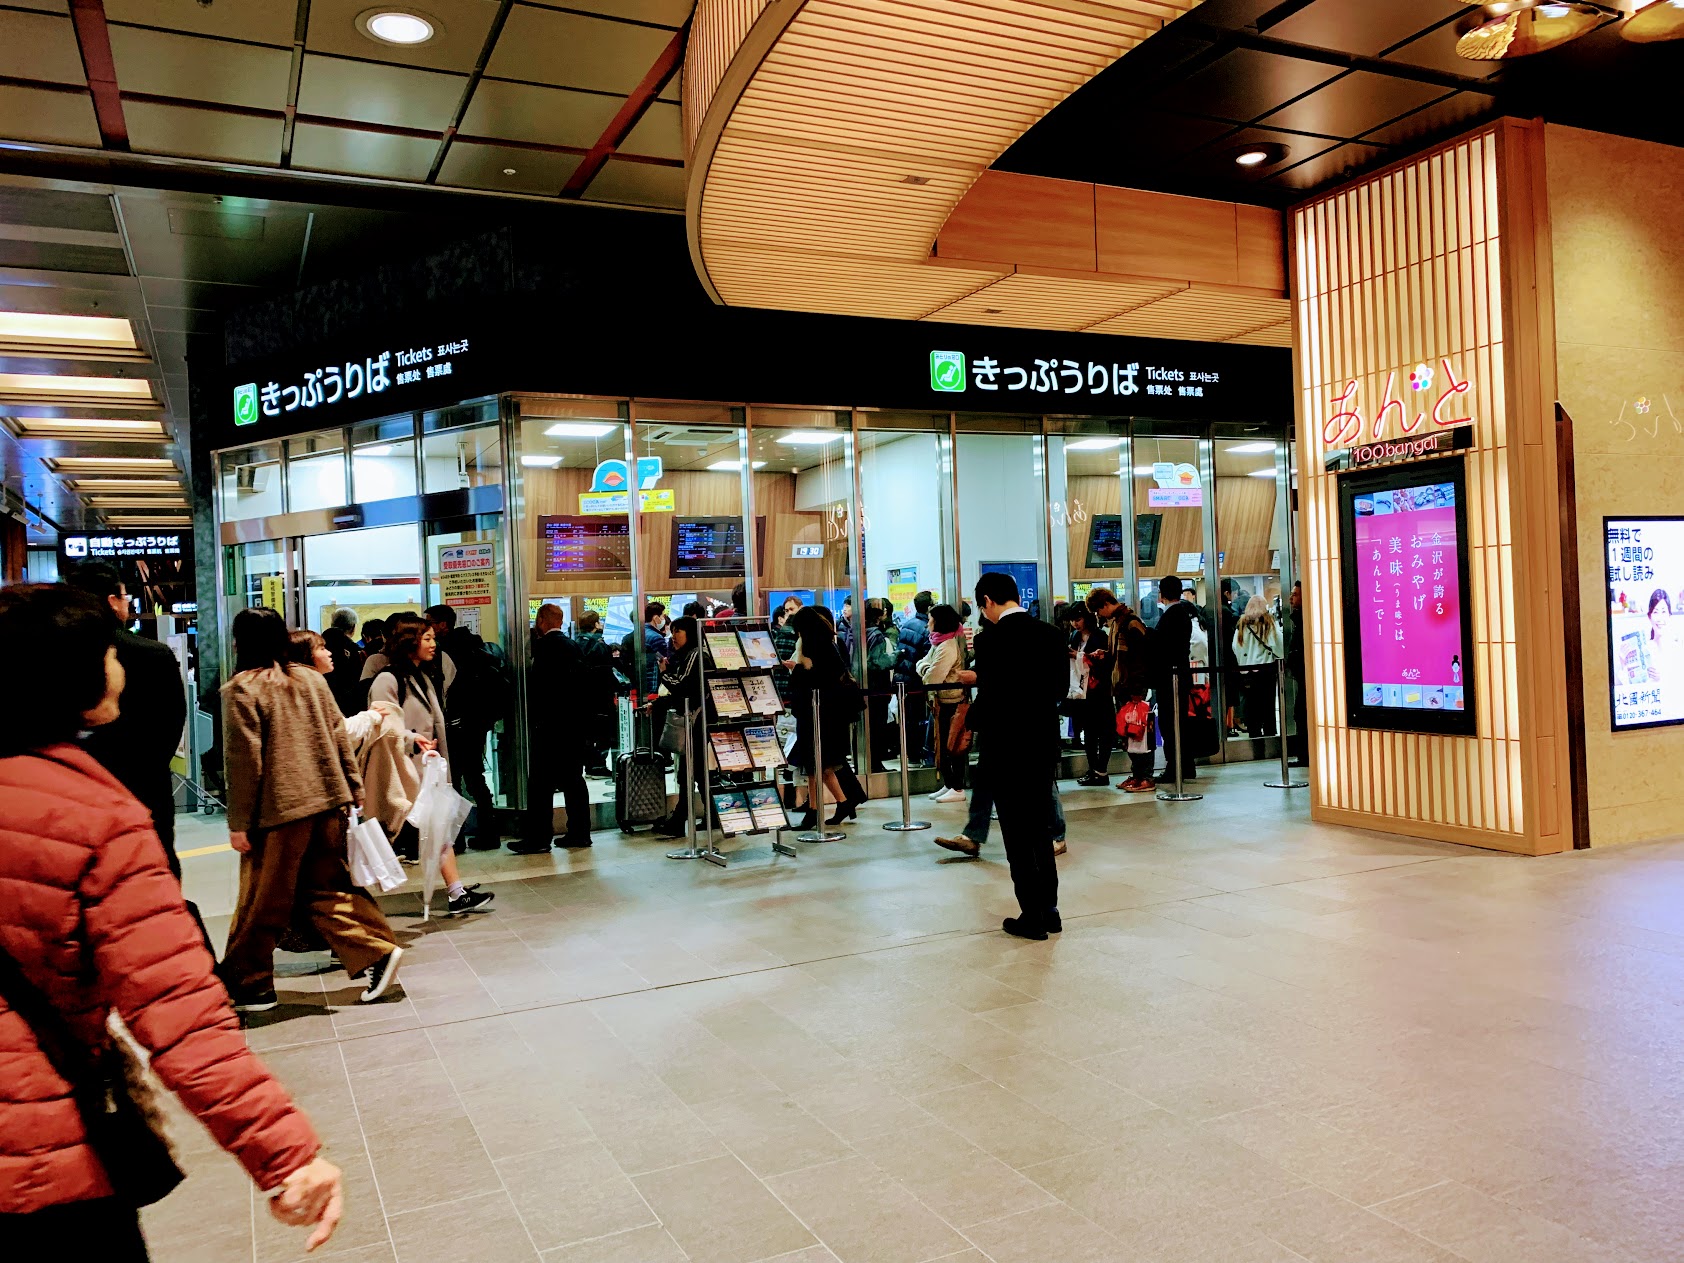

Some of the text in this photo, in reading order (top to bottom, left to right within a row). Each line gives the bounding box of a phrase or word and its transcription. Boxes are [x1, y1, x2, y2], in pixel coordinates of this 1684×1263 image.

[395, 339, 469, 367] Tickets 표사는곳
[261, 351, 391, 416] きっぷうりば
[972, 356, 1139, 395] きっぷうりば
[1145, 366, 1220, 382] Tickets 표사는곳
[1323, 358, 1476, 444] あんと
[1352, 436, 1438, 463] 100bangai
[89, 535, 179, 549] 自動きっぷうりば
[1607, 527, 1641, 544] 無料で
[90, 548, 116, 556] Tickets
[1612, 546, 1654, 563] 1週間の
[1410, 534, 1426, 611] おみやげ
[1431, 532, 1444, 615] 金沢が誇る
[1609, 565, 1654, 582] 試し読み
[1021, 588, 1034, 599] IS
